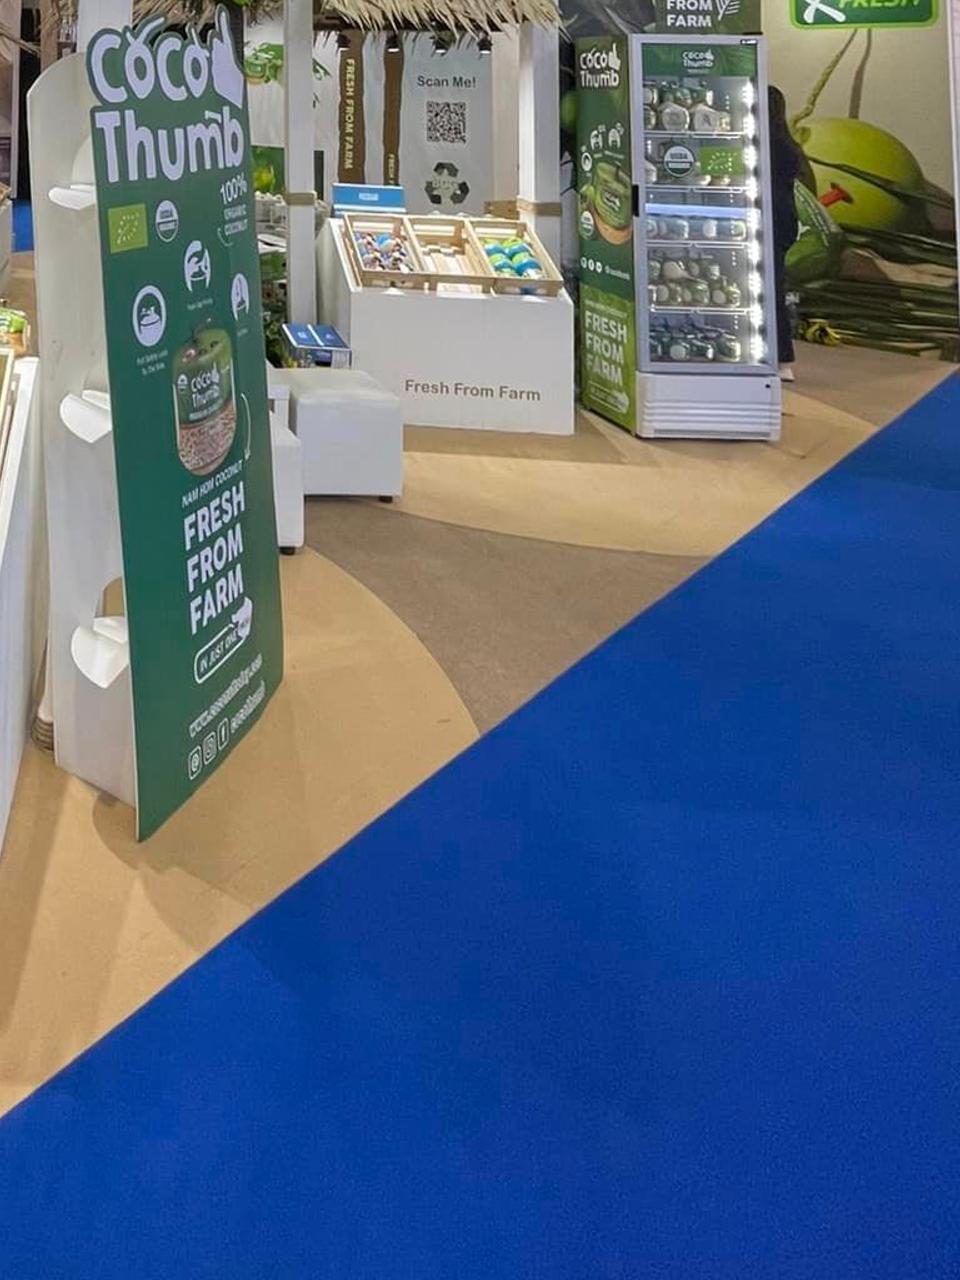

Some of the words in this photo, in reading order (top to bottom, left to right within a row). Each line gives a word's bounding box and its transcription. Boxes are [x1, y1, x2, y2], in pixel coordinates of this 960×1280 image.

[666, 14, 712, 27] FARM
[345, 58, 355, 96] FRESH
[417, 75, 449, 88] Scan
[452, 75, 476, 88] Me!
[580, 69, 620, 88] Thumb
[344, 99, 354, 133] FROM
[95, 106, 244, 183] Thumb
[343, 136, 354, 169] FARM
[220, 173, 248, 205] 100%
[585, 310, 627, 344] FRESH
[585, 331, 624, 365] FROM
[405, 379, 449, 395] Fresh
[454, 382, 494, 398] From
[499, 386, 541, 401] Farm
[184, 480, 245, 551] FRESH
[187, 523, 243, 593] FROM
[190, 563, 243, 635] FARM
